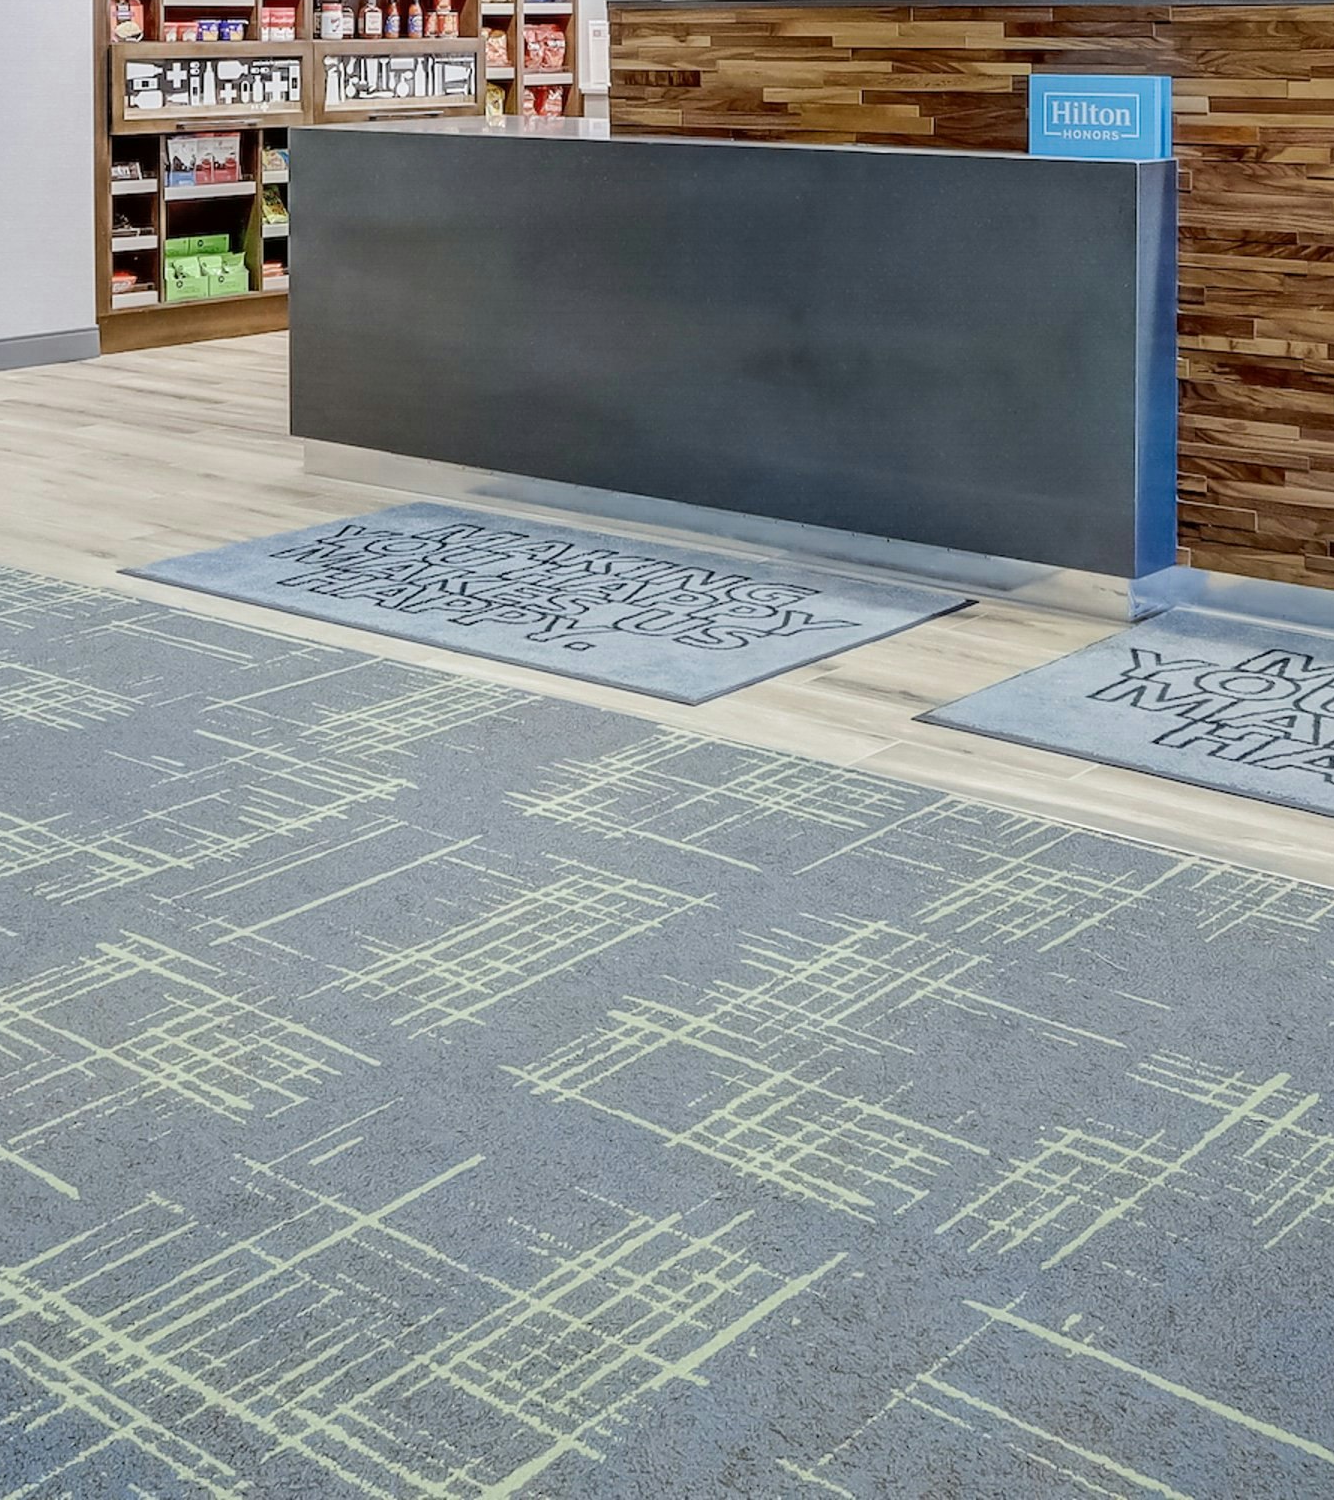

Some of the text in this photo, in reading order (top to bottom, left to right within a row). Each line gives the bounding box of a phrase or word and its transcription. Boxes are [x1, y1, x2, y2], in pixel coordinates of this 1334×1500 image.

[1051, 100, 1131, 126] Hilton
[1063, 129, 1119, 141] HONORS
[270, 543, 768, 650] MAKES US
[317, 524, 862, 637] YOU HAPPY
[412, 523, 822, 607] MAKING
